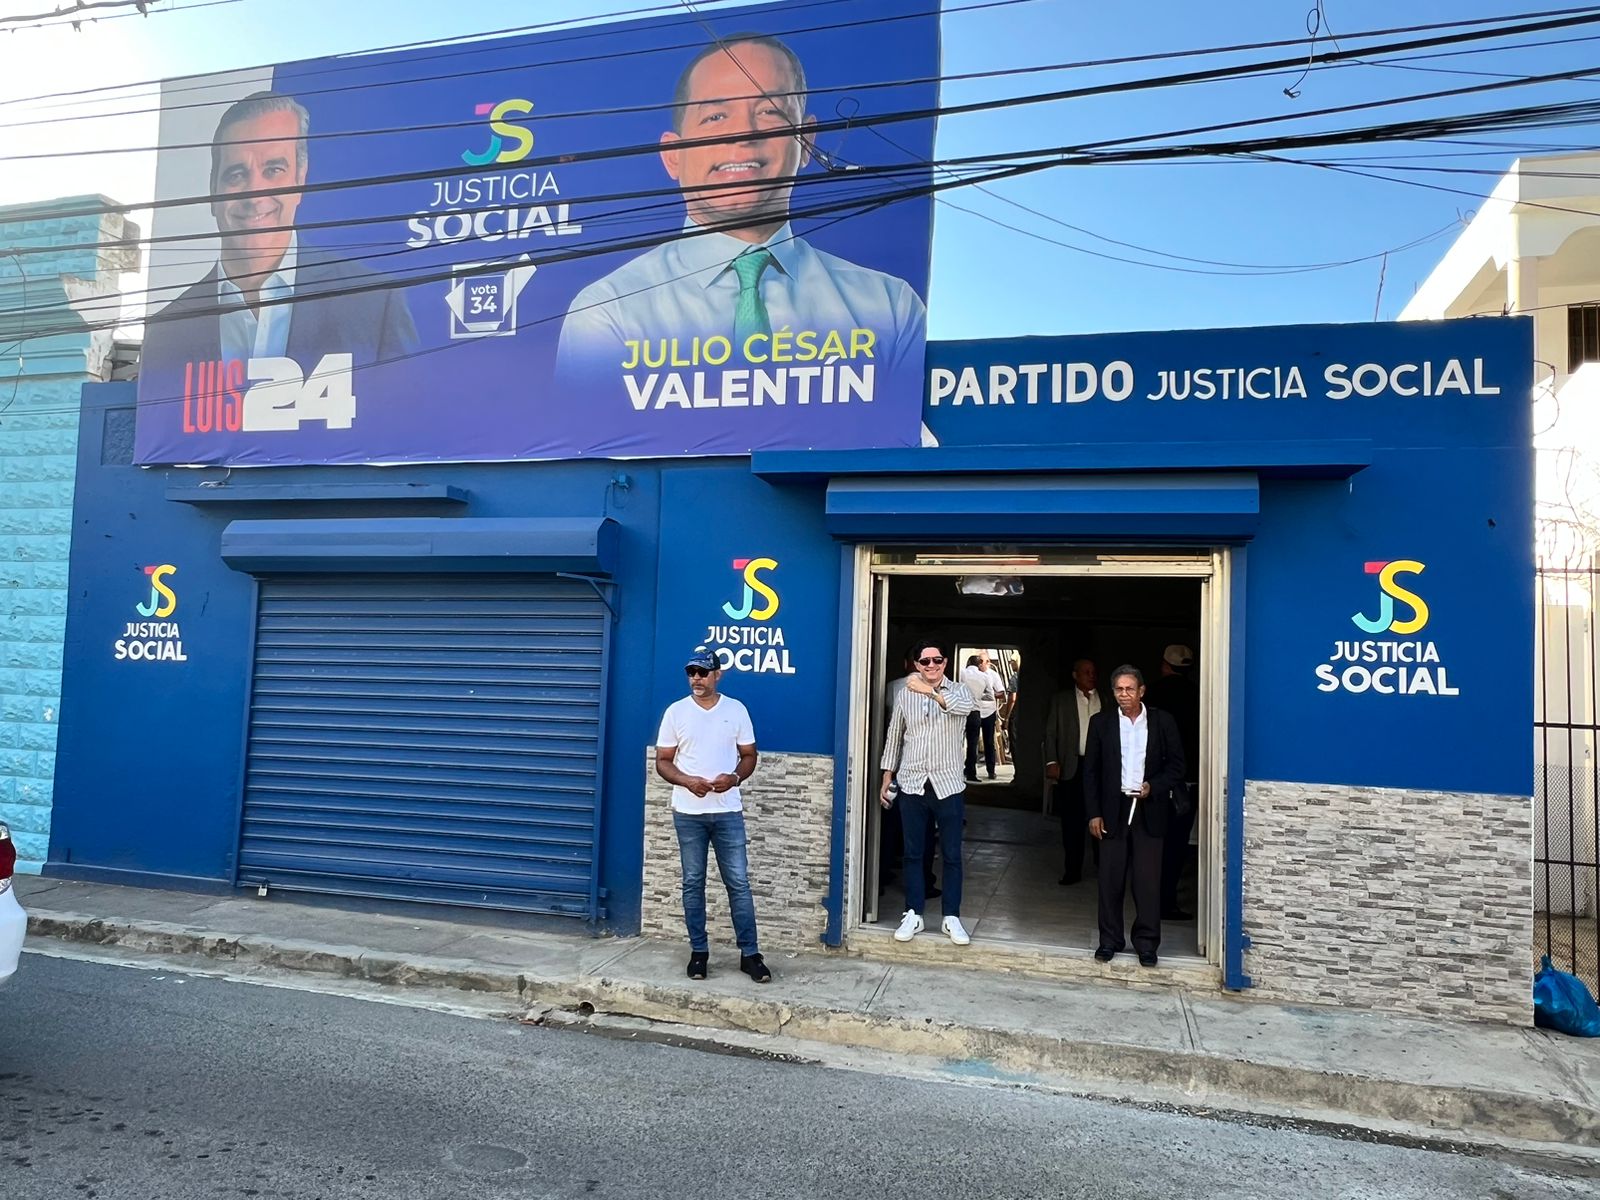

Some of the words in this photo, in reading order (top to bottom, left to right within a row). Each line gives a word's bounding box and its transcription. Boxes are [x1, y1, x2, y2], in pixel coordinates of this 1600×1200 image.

[461, 98, 535, 166] JS
[430, 171, 560, 207] JUSTICIA
[407, 203, 582, 249] SOCIAL
[470, 296, 498, 314] 34
[471, 284, 498, 295] vota
[622, 335, 732, 369] JULIO
[743, 325, 876, 364] CÉSAR
[622, 356, 875, 411] VALENTÍN
[930, 360, 1134, 406] PARTIDO
[1147, 366, 1307, 401] JUSTICIA
[1324, 358, 1500, 399] SOCIAL
[136, 564, 177, 618] JS
[722, 557, 779, 620] JS
[1351, 559, 1429, 635] JS
[114, 639, 187, 661] SOCIAL
[123, 622, 180, 638] JUSTICIA
[704, 625, 785, 646] JUSTICIA
[1330, 640, 1440, 663] JUSTICIA
[1315, 664, 1460, 696] SOCIAL
